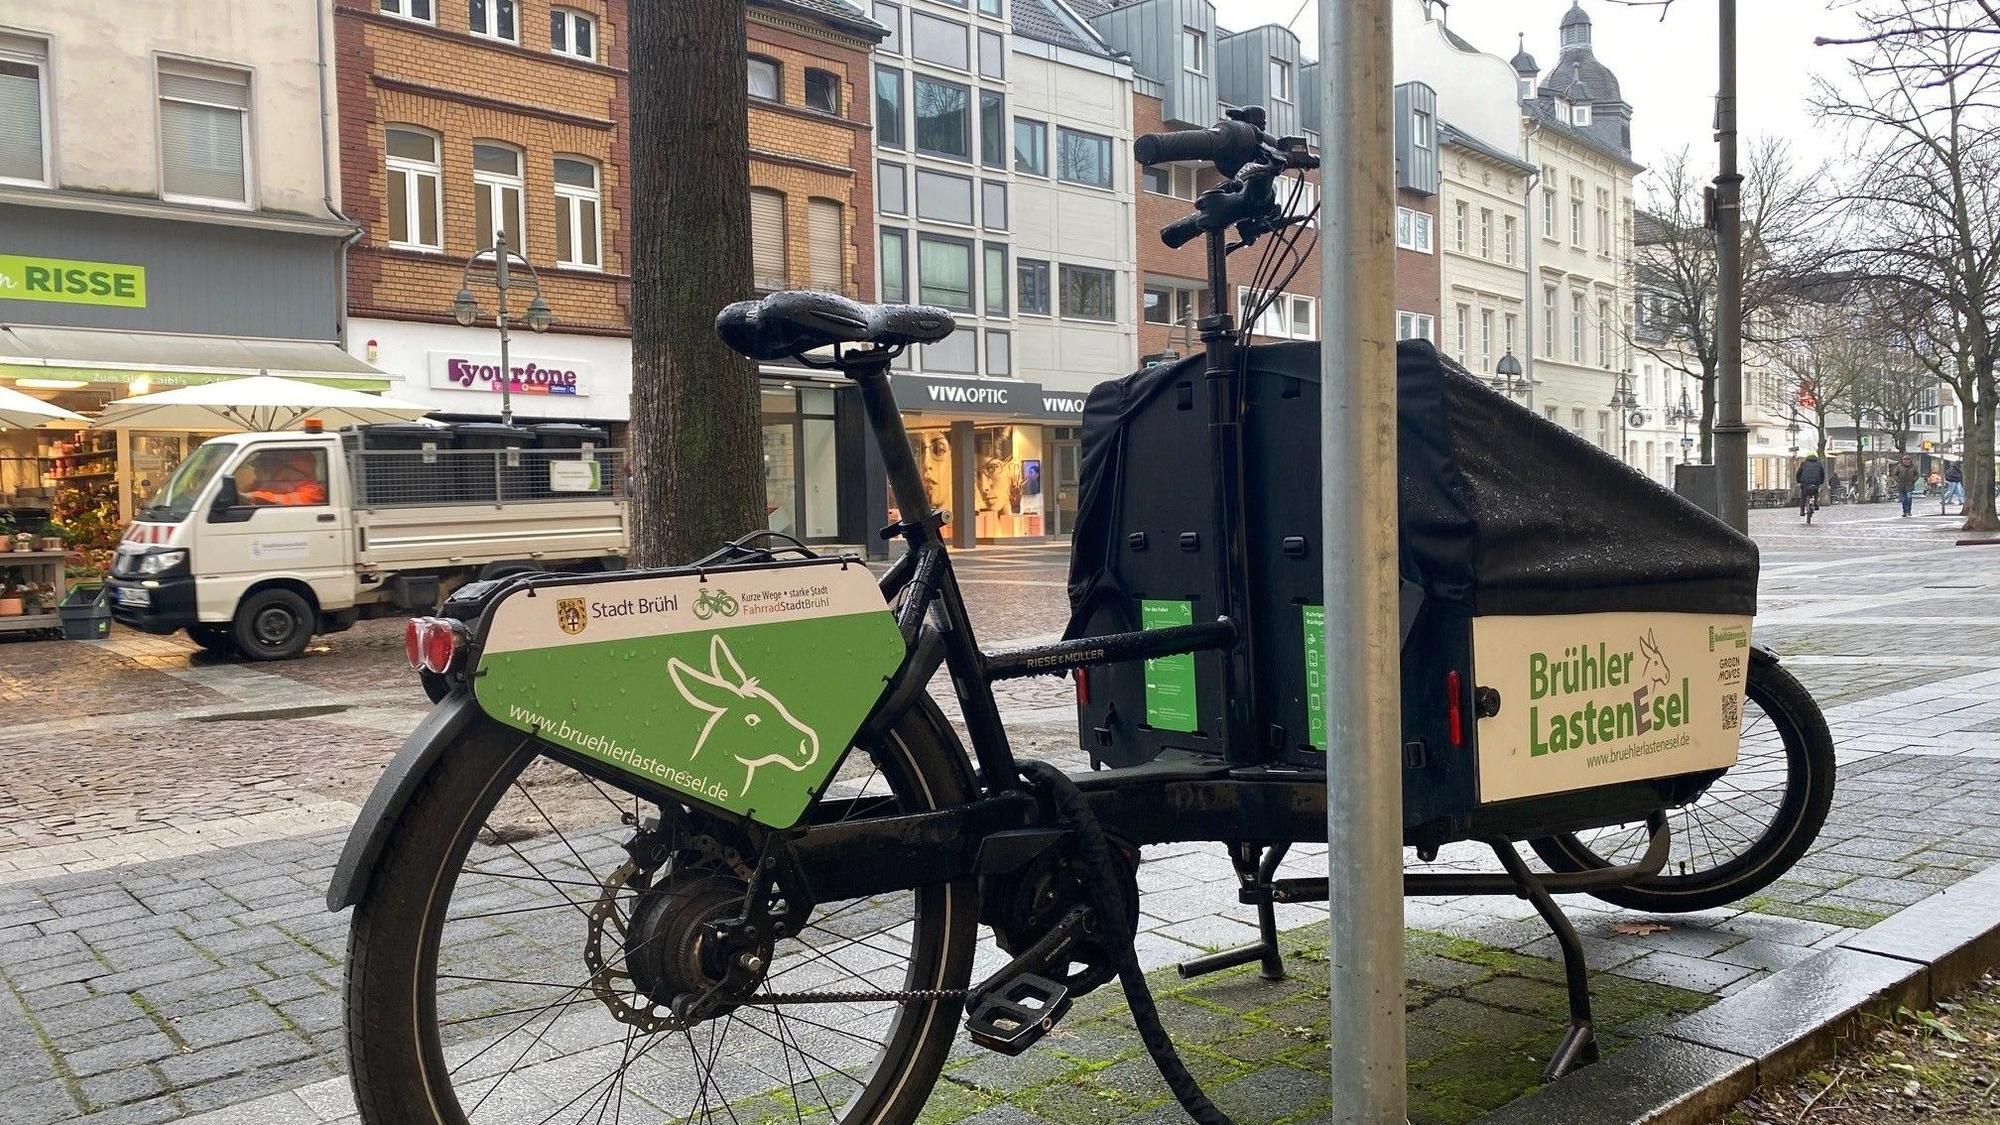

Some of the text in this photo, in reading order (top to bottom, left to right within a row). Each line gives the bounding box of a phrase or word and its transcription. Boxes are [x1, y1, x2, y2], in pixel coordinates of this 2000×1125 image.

[25, 265, 136, 298] RISSE
[927, 385, 1008, 404] VIVAOPTIC
[1043, 398, 1085, 413] VIVAO
[591, 594, 678, 618] Stadt Brühl
[741, 585, 829, 602] Kurze Wege starke Stadt
[1027, 655, 1057, 669] RIESE
[1530, 642, 1633, 700] Brühler
[1530, 677, 1690, 758] LastenEsel
[509, 704, 729, 802] www.bruehlerlastenesel.de
[1586, 733, 1690, 769] www.bruehlerlastenesel.de
